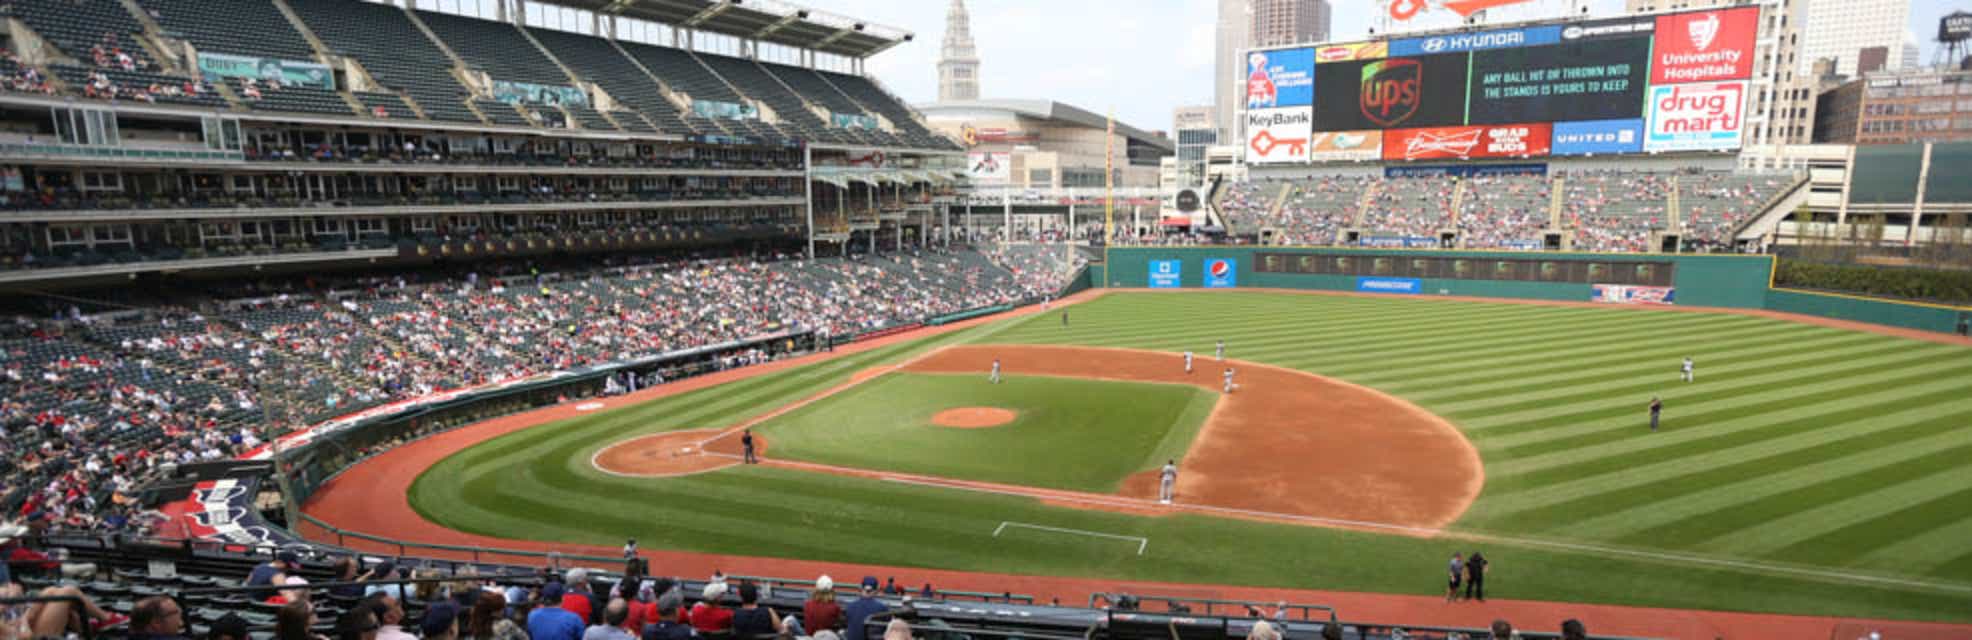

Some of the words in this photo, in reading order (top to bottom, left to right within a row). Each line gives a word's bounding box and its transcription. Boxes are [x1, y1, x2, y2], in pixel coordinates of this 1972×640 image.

[1450, 31, 1525, 49] HYUNDAI
[1662, 50, 1742, 65] University
[1483, 73, 1502, 84] ANY
[1503, 71, 1527, 83] BALL
[1529, 69, 1544, 81] HIT
[1546, 68, 1561, 80] OR
[1562, 66, 1605, 79] THROWN
[1606, 64, 1631, 76] INTO
[1664, 63, 1737, 80] Hospitals
[1366, 79, 1416, 116] ups
[1484, 87, 1500, 98] THE
[1503, 84, 1539, 97] STANDS
[1540, 84, 1551, 96] IS
[1553, 82, 1585, 95] YOURS
[1587, 81, 1600, 93] TO
[1660, 86, 1726, 115] drug
[1249, 112, 1309, 127] KeyBank
[1663, 113, 1735, 132] mart
[1488, 128, 1530, 138] GRAB
[1557, 132, 1616, 143] UNITED
